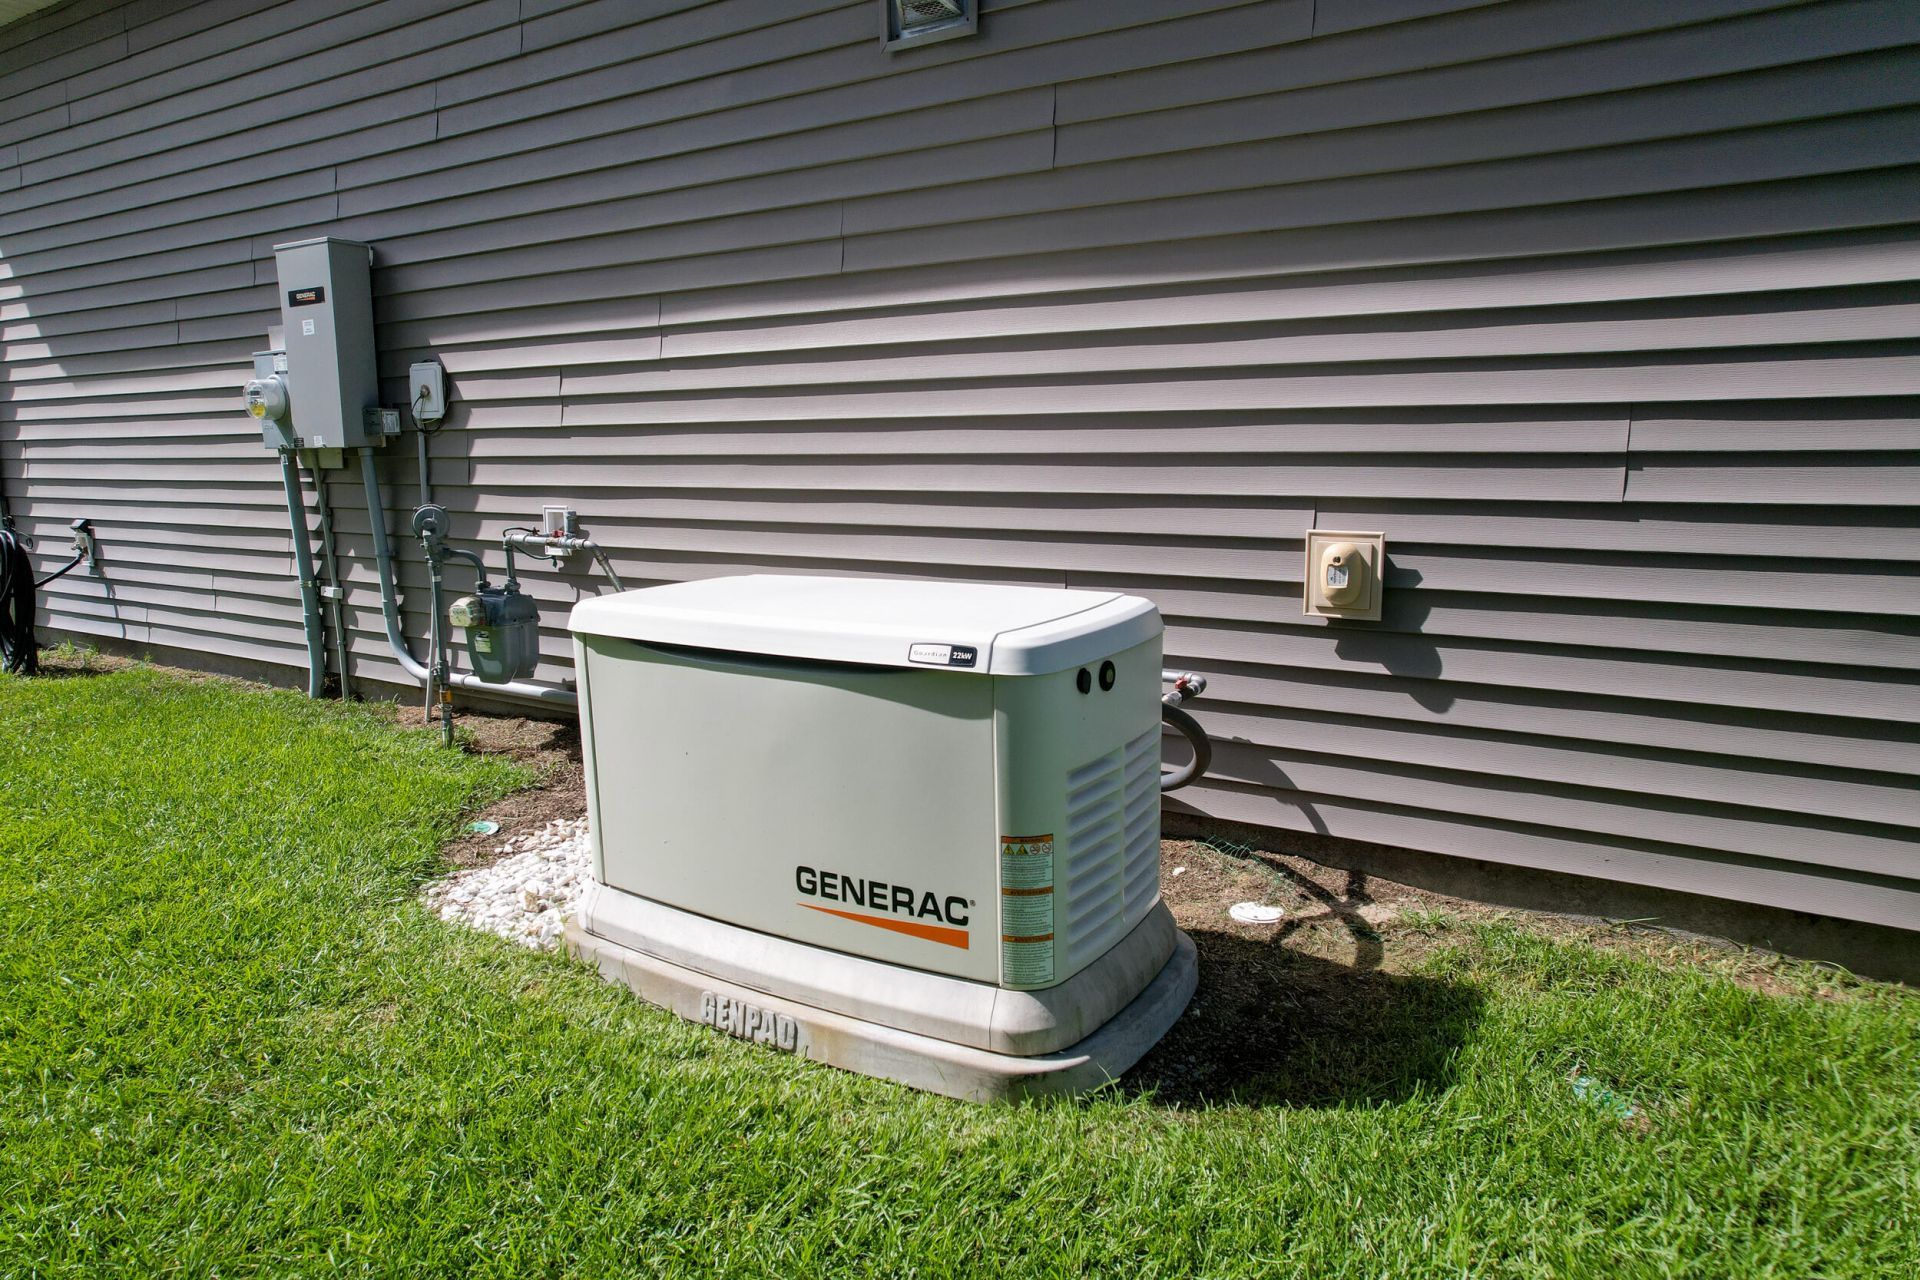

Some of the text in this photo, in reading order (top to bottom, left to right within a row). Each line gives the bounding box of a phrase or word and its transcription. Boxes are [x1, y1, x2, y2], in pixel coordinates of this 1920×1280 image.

[952, 651, 973, 660] 22kW
[795, 865, 970, 927] GENERAC
[701, 990, 798, 1054] GENPAD
